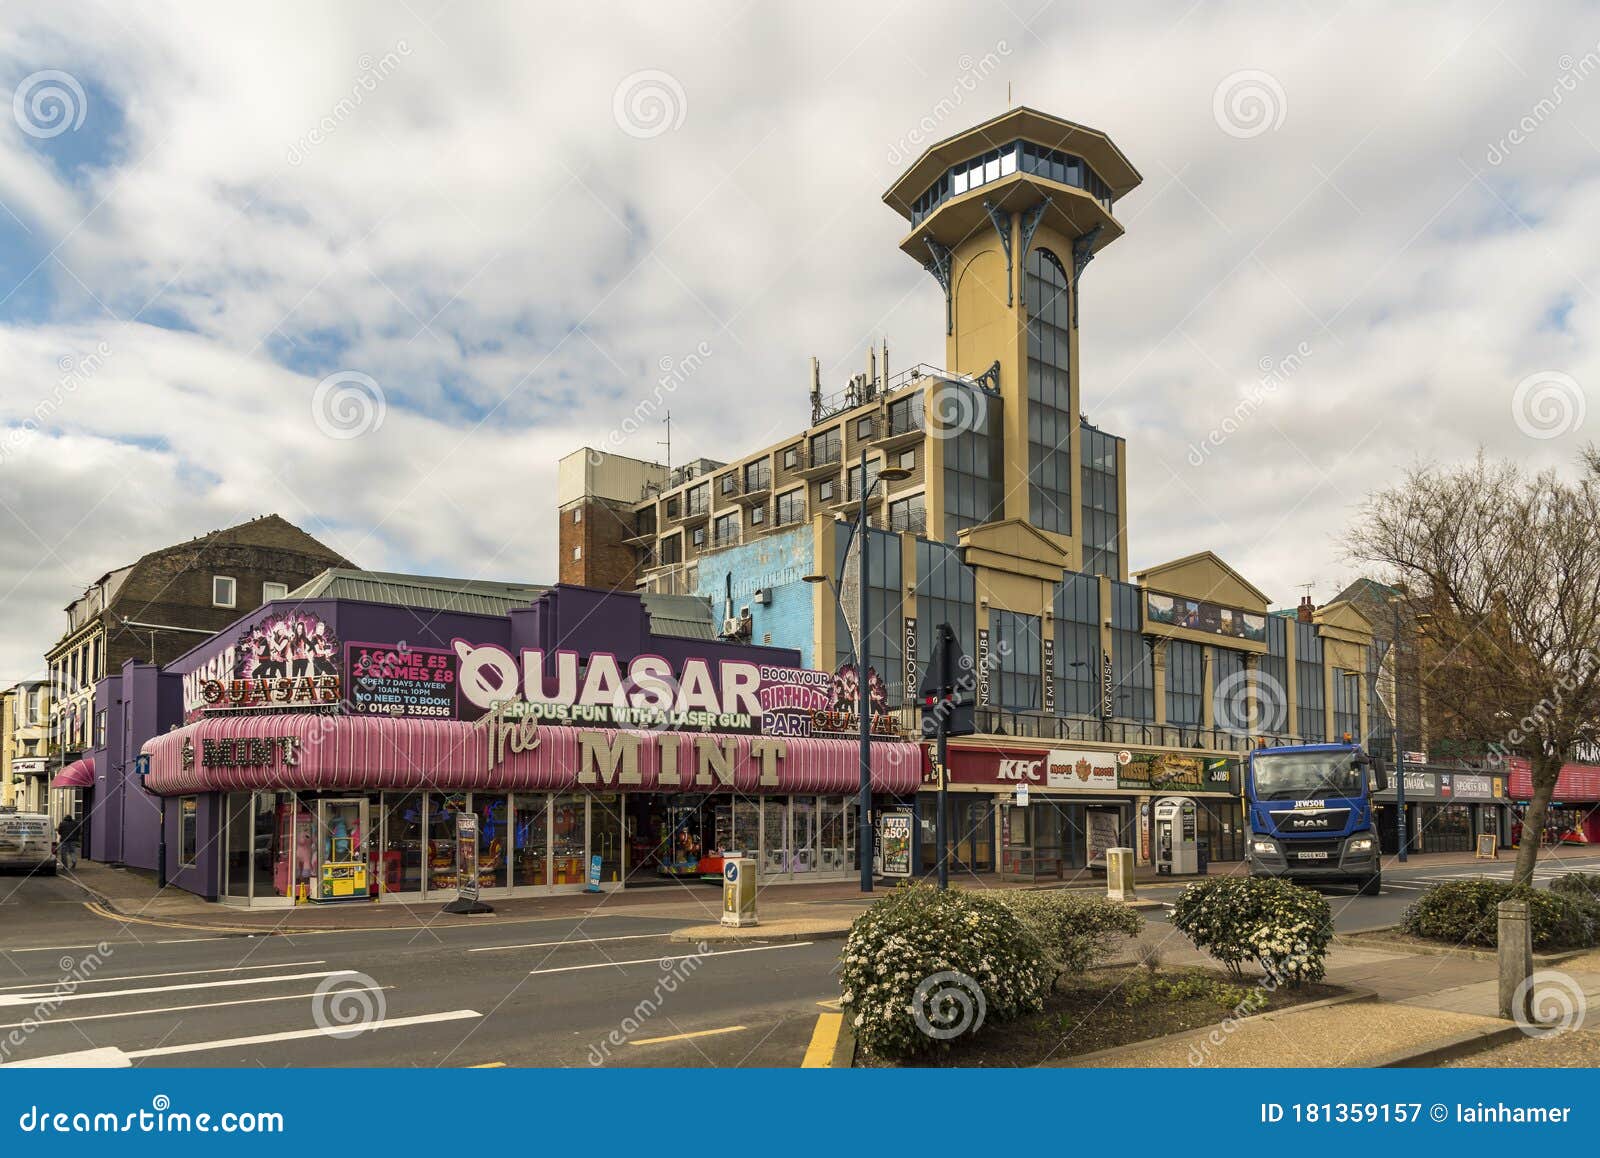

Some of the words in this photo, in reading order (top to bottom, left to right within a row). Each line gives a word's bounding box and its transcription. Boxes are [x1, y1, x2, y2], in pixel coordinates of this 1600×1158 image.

[372, 651, 423, 667] GAME
[427, 655, 447, 669] £5
[906, 628, 916, 693] ROOFTOP
[353, 663, 363, 677] 2
[369, 664, 430, 681] GAMES
[434, 670, 454, 683] £8
[361, 677, 384, 685] OPEN
[452, 640, 763, 719] QUASAR
[761, 667, 795, 682] BOOK
[799, 672, 831, 687] YOUR
[980, 639, 989, 706] NIGHTCLUB
[1045, 648, 1054, 706] EMPIRE
[200, 675, 342, 704] QUASAR
[356, 693, 371, 701] NO
[374, 694, 401, 703] NEED
[404, 696, 417, 704] TO
[420, 697, 450, 706] BOOK!
[760, 686, 829, 713] BIRTHDAY
[408, 705, 450, 716] 332656
[571, 703, 609, 722] FUN
[611, 706, 652, 722] WITH
[655, 711, 667, 724] A
[670, 711, 717, 727] LASER
[719, 713, 750, 728] GUN
[1105, 696, 1113, 718] LIVE
[473, 692, 541, 770] The
[761, 712, 811, 736] PART
[811, 709, 900, 737] QUAAR
[202, 736, 300, 769] MINT
[578, 731, 787, 787] MINT
[1576, 742, 1600, 761] PALA
[996, 759, 1042, 780] KFC
[1210, 770, 1230, 782] SUB
[1392, 776, 1425, 790] LDMARK
[1456, 781, 1476, 792] SPORTS
[1294, 799, 1325, 808] JEWSON
[883, 827, 910, 839] £500
[886, 817, 908, 829] WIN
[1293, 819, 1328, 827] MAN
